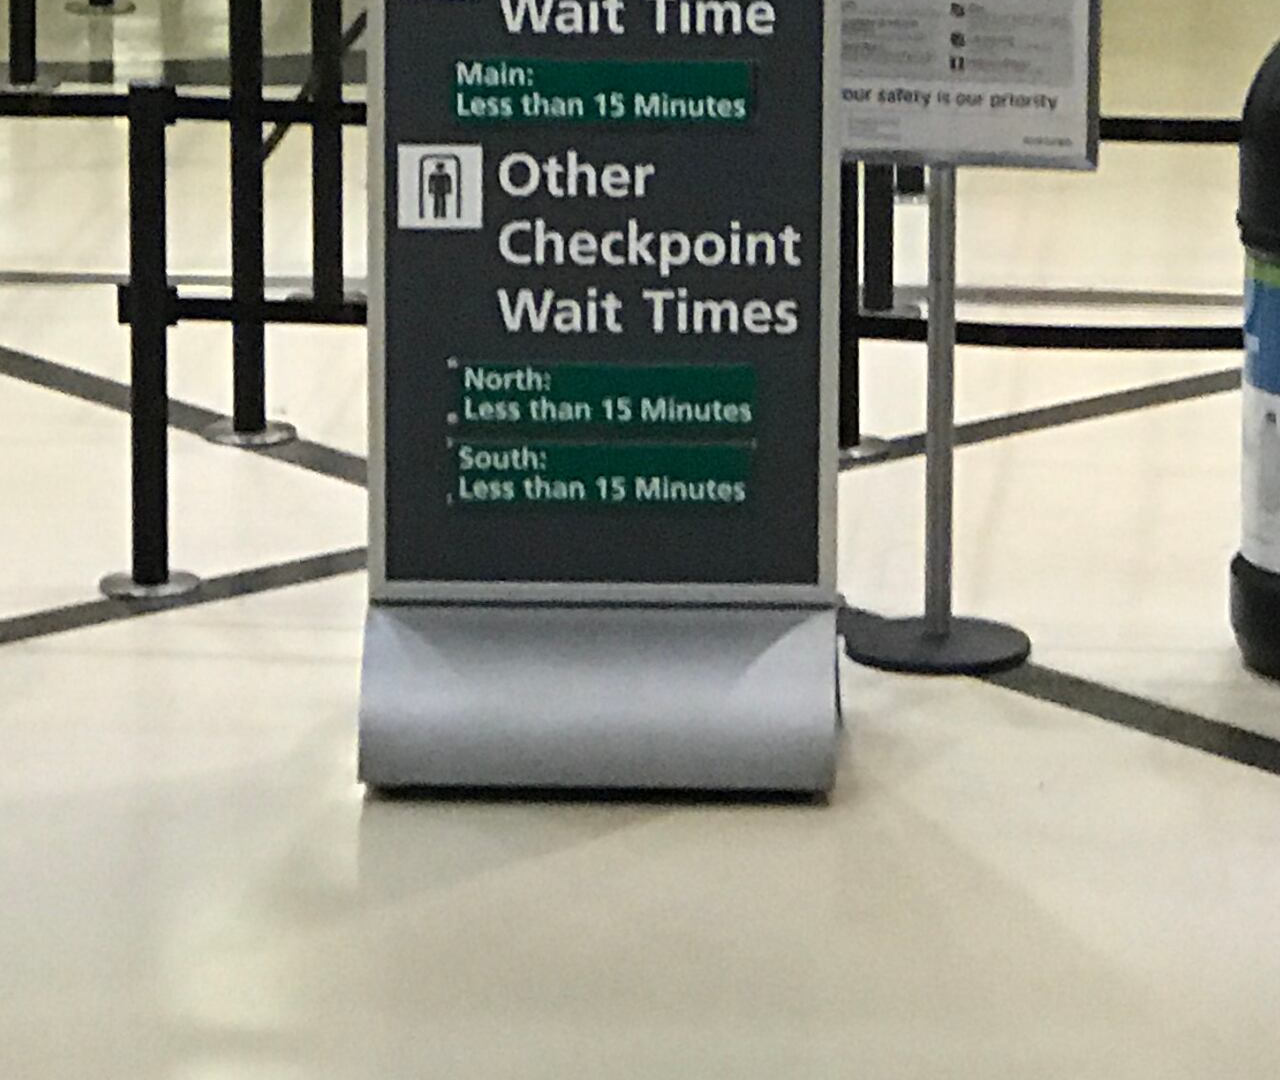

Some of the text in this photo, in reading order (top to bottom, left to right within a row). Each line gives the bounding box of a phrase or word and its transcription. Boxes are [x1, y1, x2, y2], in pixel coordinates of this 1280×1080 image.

[455, 61, 534, 87] Main:
[456, 91, 746, 119] Less than 15 Minutes
[876, 88, 932, 107] safety
[937, 90, 951, 104] is
[955, 92, 985, 107] our
[989, 93, 1059, 112] priority
[498, 150, 655, 198] Other
[498, 217, 801, 277] Checkpoint
[496, 287, 798, 334] Wait Times
[464, 366, 551, 391] North:
[464, 396, 752, 423] Less than 15 Minutes
[458, 445, 547, 470] South:
[459, 474, 746, 502] Less than 15 Minutes
